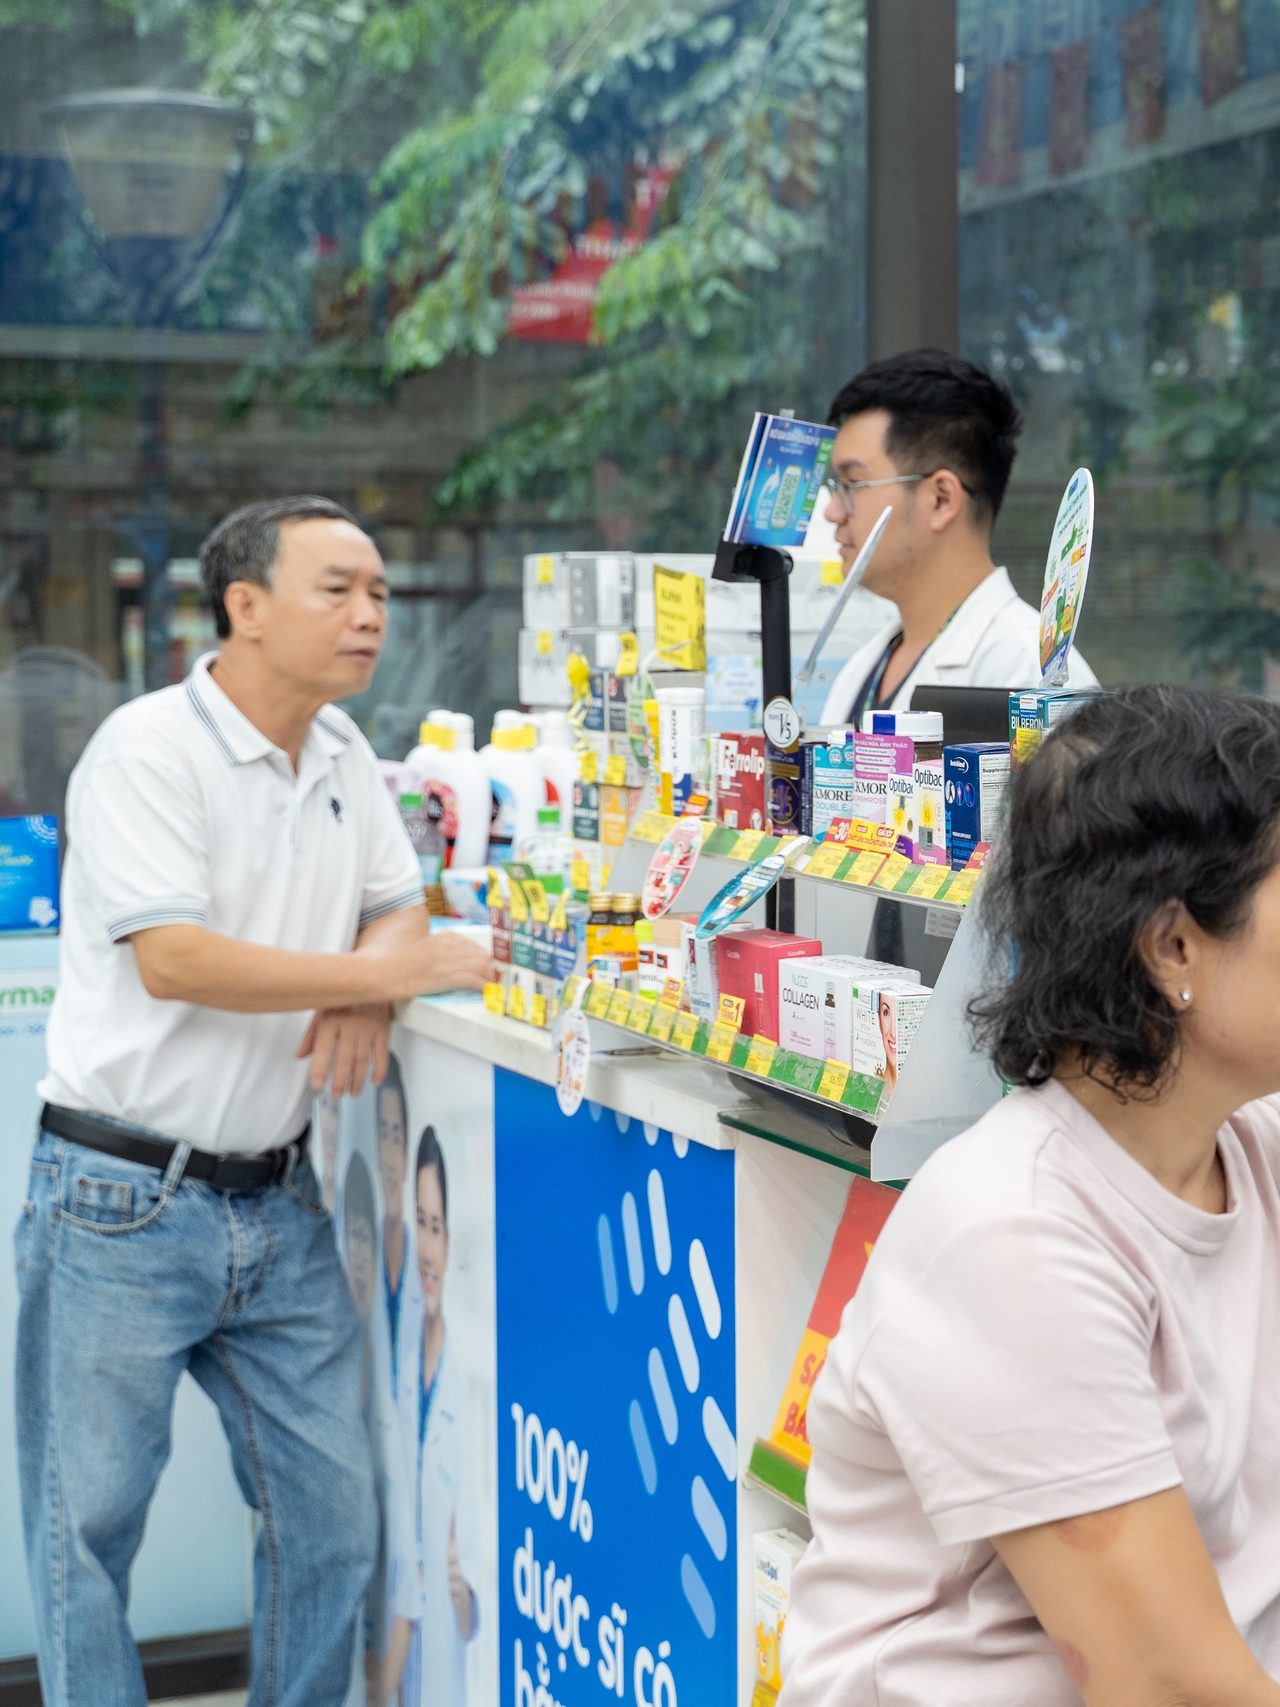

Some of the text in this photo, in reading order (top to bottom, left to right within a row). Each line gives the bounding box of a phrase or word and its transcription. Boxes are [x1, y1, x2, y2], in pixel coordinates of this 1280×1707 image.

[723, 745, 766, 781] Ferrolip
[914, 769, 943, 788] Optibac
[815, 801, 848, 812] DOUBLE
[782, 987, 820, 1011] COLLAGEN
[855, 1006, 876, 1026] WHITE
[511, 1402, 594, 1543] 100%
[512, 1526, 678, 1707] dược sĩ có
